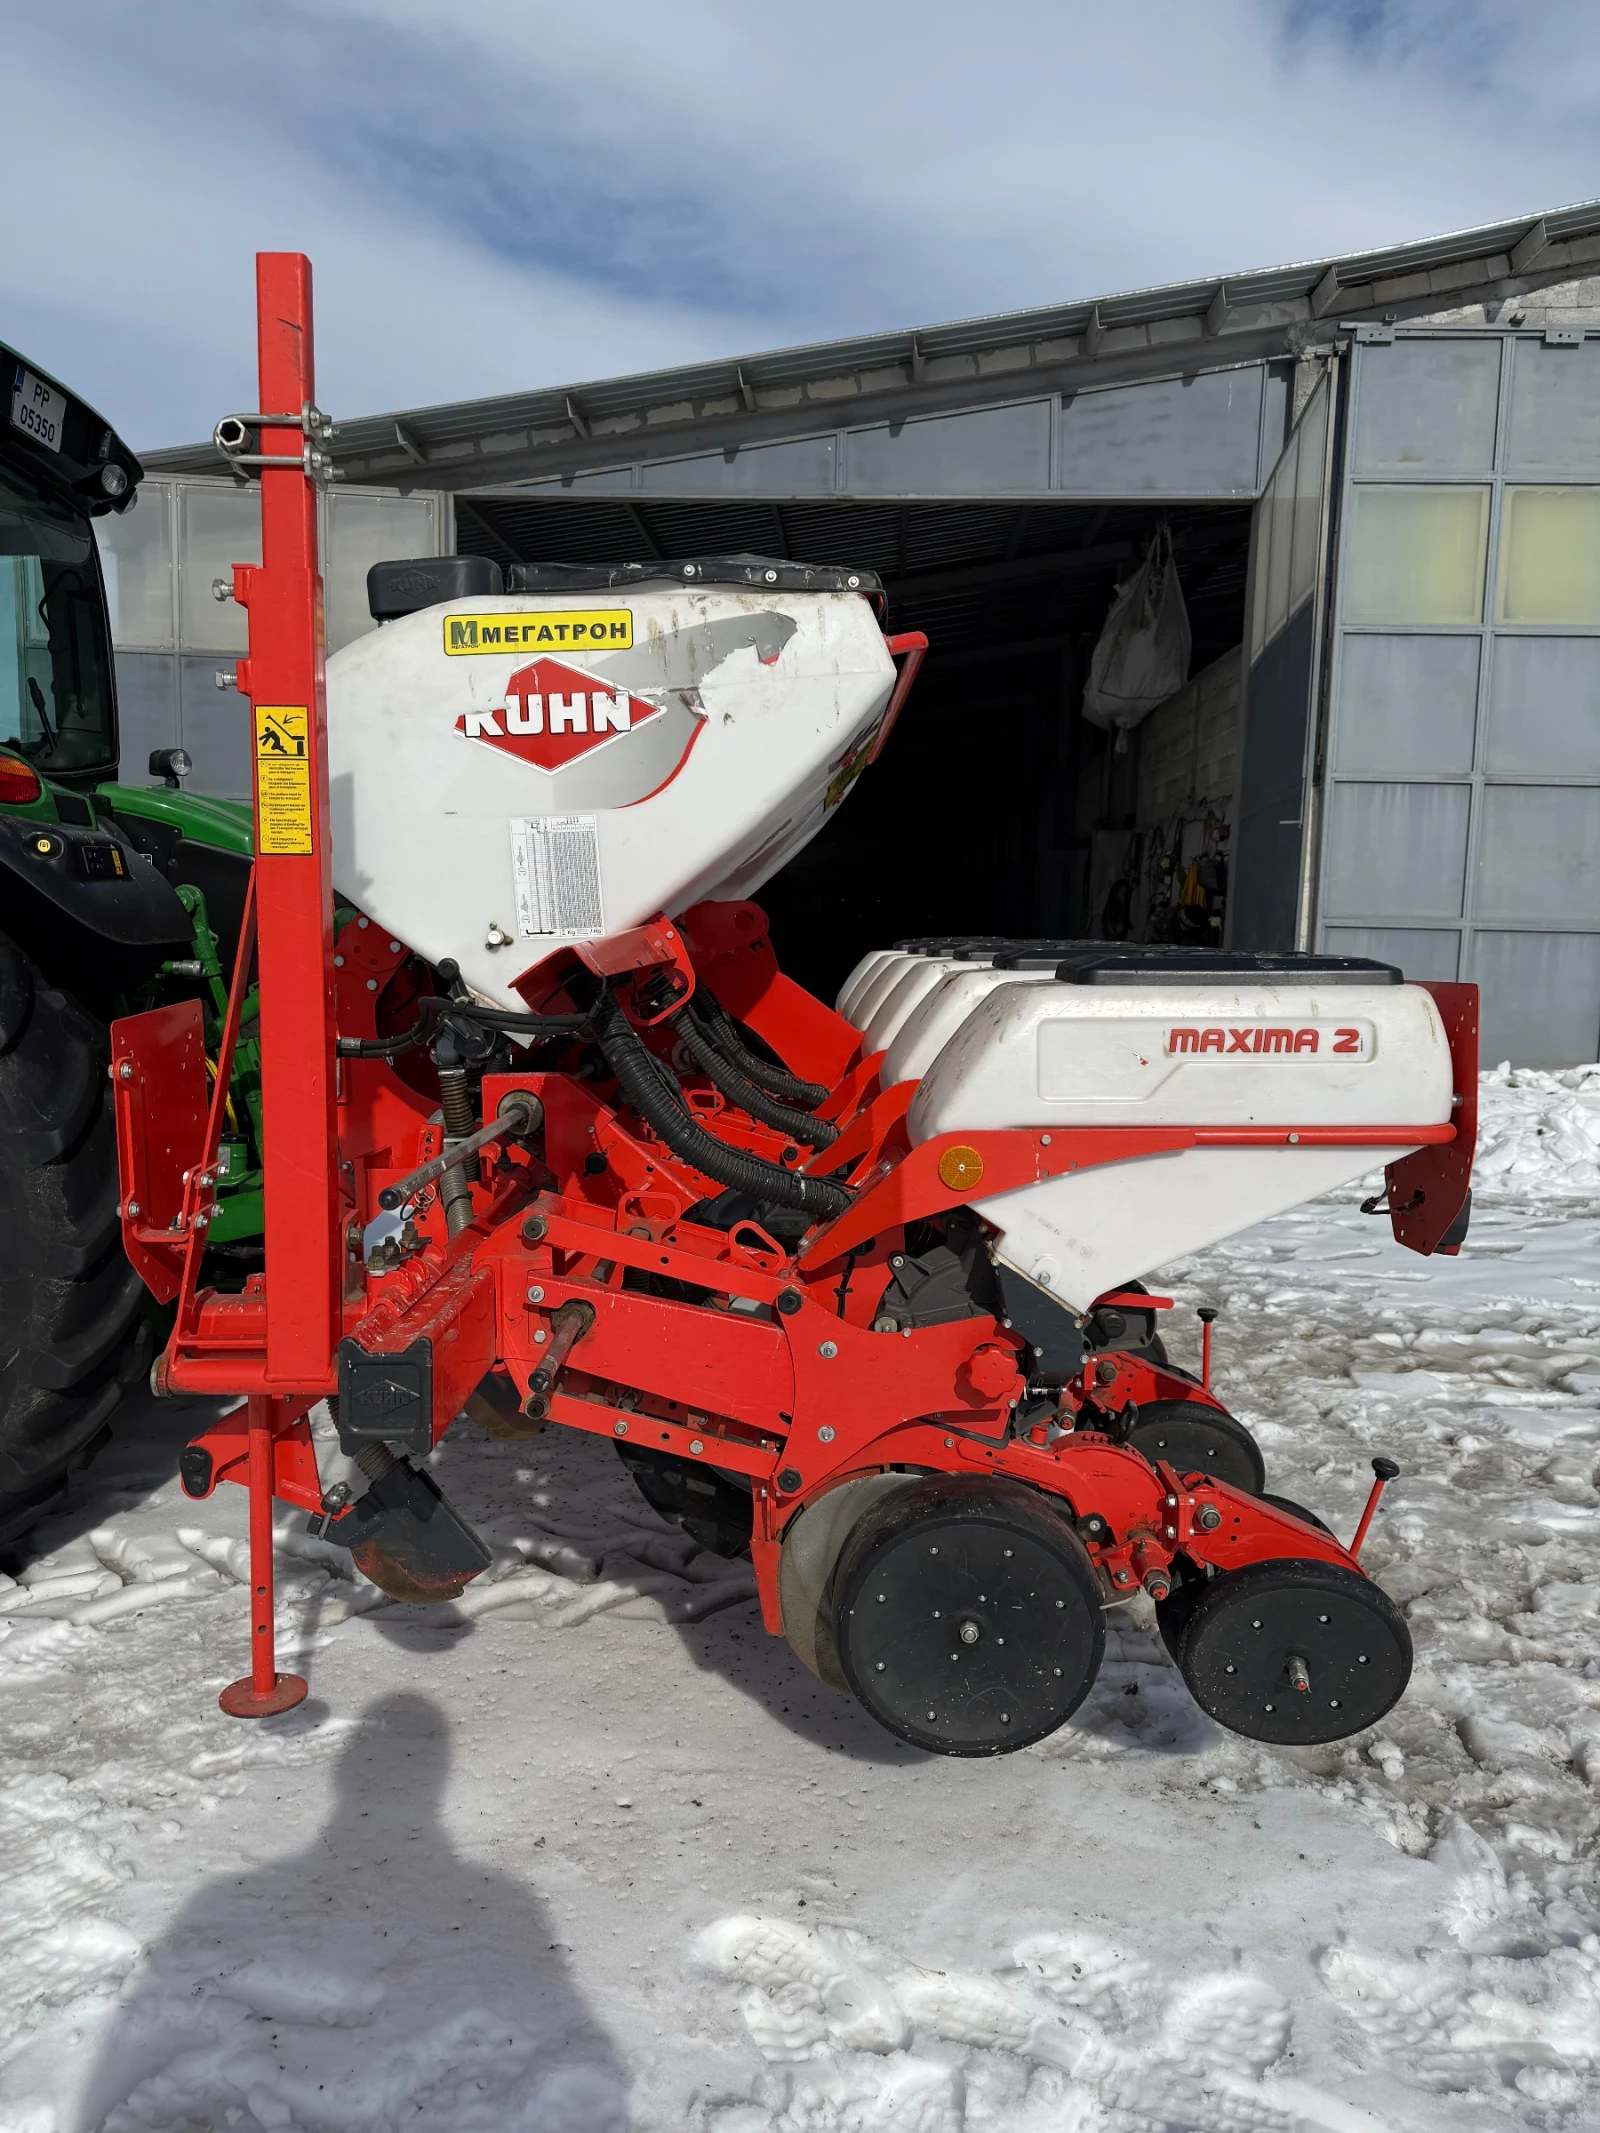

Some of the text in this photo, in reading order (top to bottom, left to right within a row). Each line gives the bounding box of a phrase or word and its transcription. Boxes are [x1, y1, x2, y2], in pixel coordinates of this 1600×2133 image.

[33, 383, 50, 407] PP
[20, 404, 55, 443] 05350
[482, 622, 627, 643] МЕГАТРОН
[1168, 1028, 1320, 1053] MAXIMA
[1332, 1028, 1360, 1053] 2
